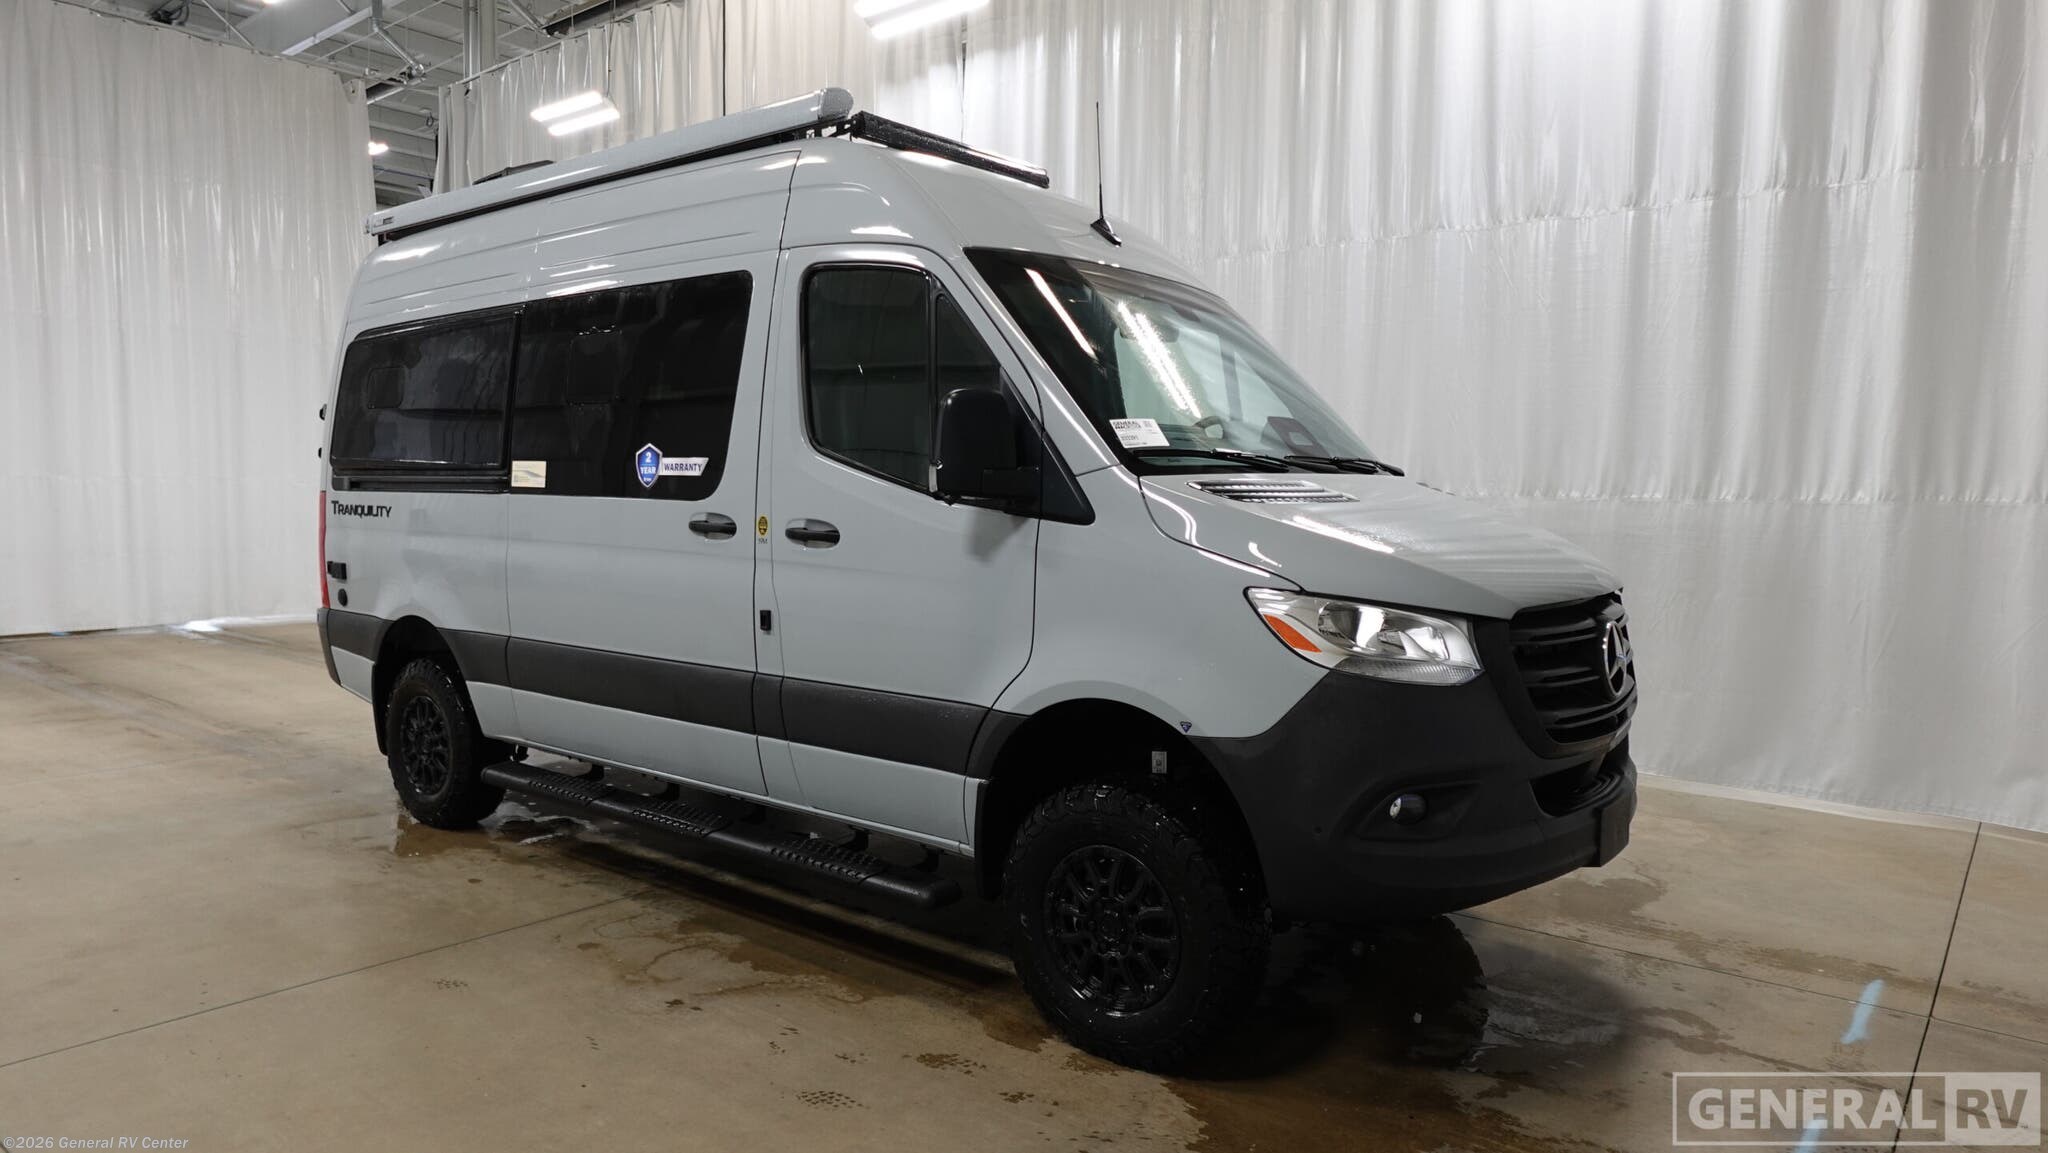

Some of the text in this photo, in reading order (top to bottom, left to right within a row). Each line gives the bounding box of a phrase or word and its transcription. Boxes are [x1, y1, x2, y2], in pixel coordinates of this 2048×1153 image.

[645, 451, 652, 463] 2
[640, 463, 703, 475] YEAR WARRANTY
[331, 500, 392, 518] TRANQUILITY
